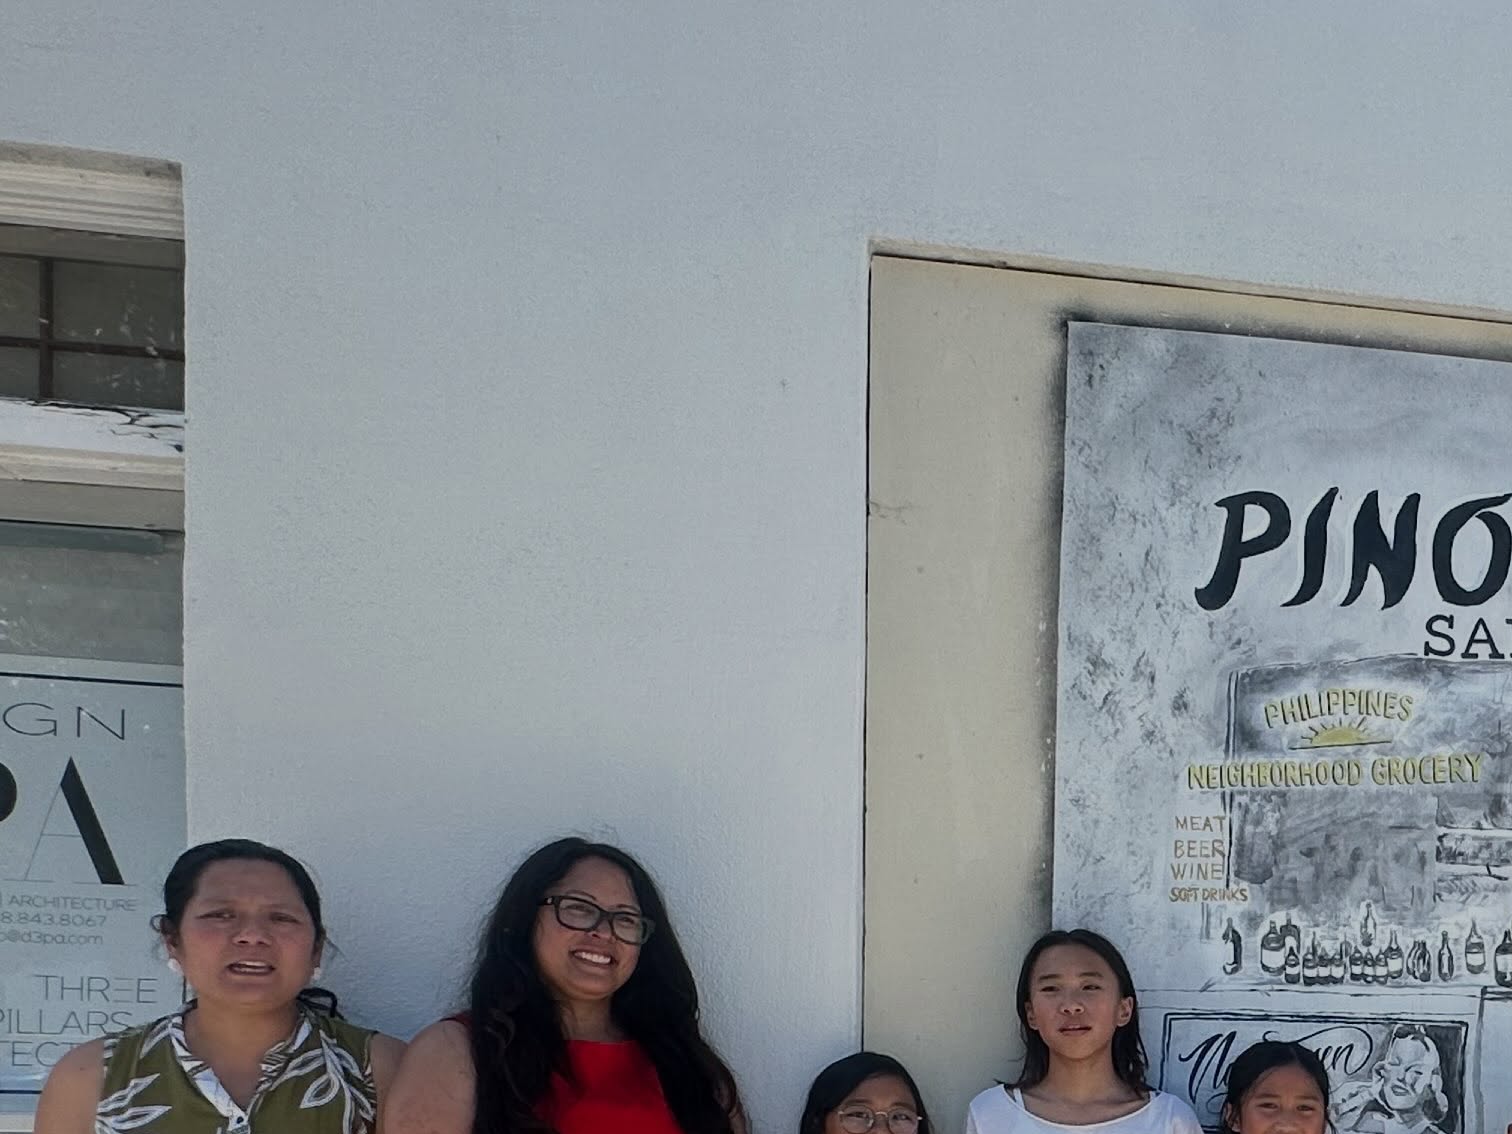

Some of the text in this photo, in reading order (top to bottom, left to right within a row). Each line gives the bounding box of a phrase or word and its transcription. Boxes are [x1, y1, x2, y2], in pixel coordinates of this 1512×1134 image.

[1264, 688, 1414, 729] PHILIPPINES
[1187, 753, 1484, 790] NEIGHBORHOOD GROCERY
[1174, 815, 1226, 832] MEAT
[1174, 839, 1225, 859] BEER
[1170, 863, 1224, 880] WINE
[8, 894, 138, 912] ARCHITECTURE
[1168, 886, 1249, 902] SOFT DRINKS
[34, 974, 158, 1004] THREE
